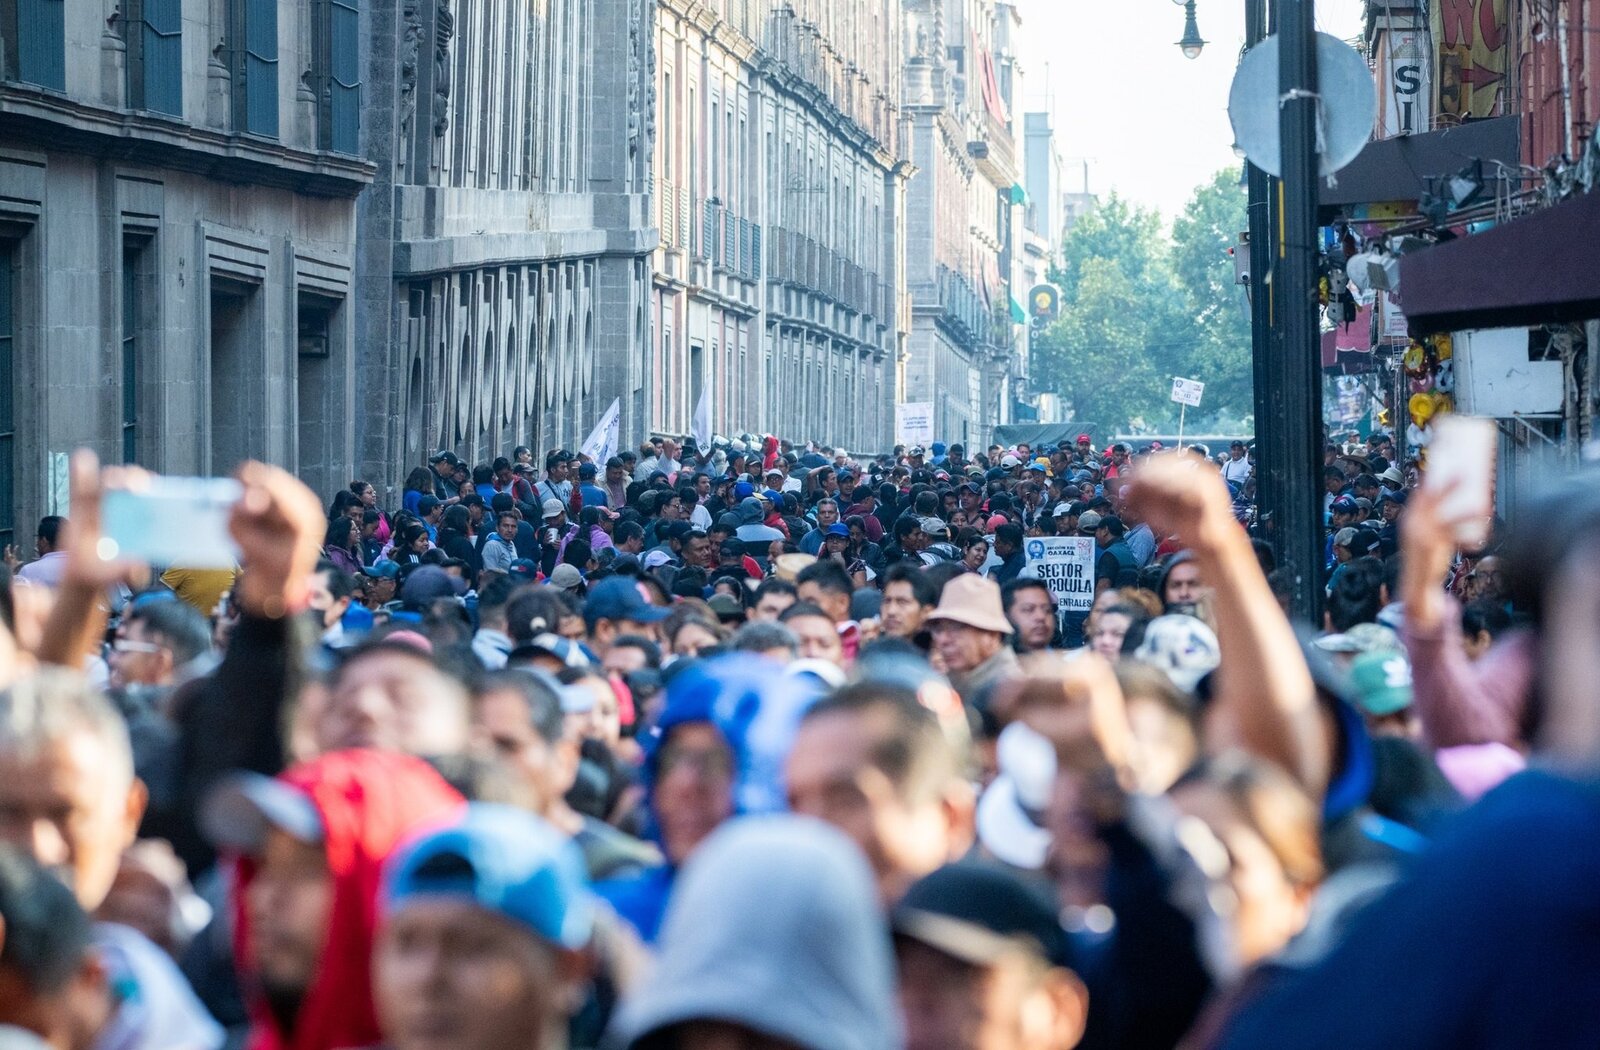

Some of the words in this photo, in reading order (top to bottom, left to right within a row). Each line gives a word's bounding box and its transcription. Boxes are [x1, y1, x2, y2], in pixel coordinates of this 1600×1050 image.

[1037, 563, 1082, 578] SECTOR
[1045, 578, 1092, 593] COLULA
[1059, 598, 1092, 607] ENTRALES
